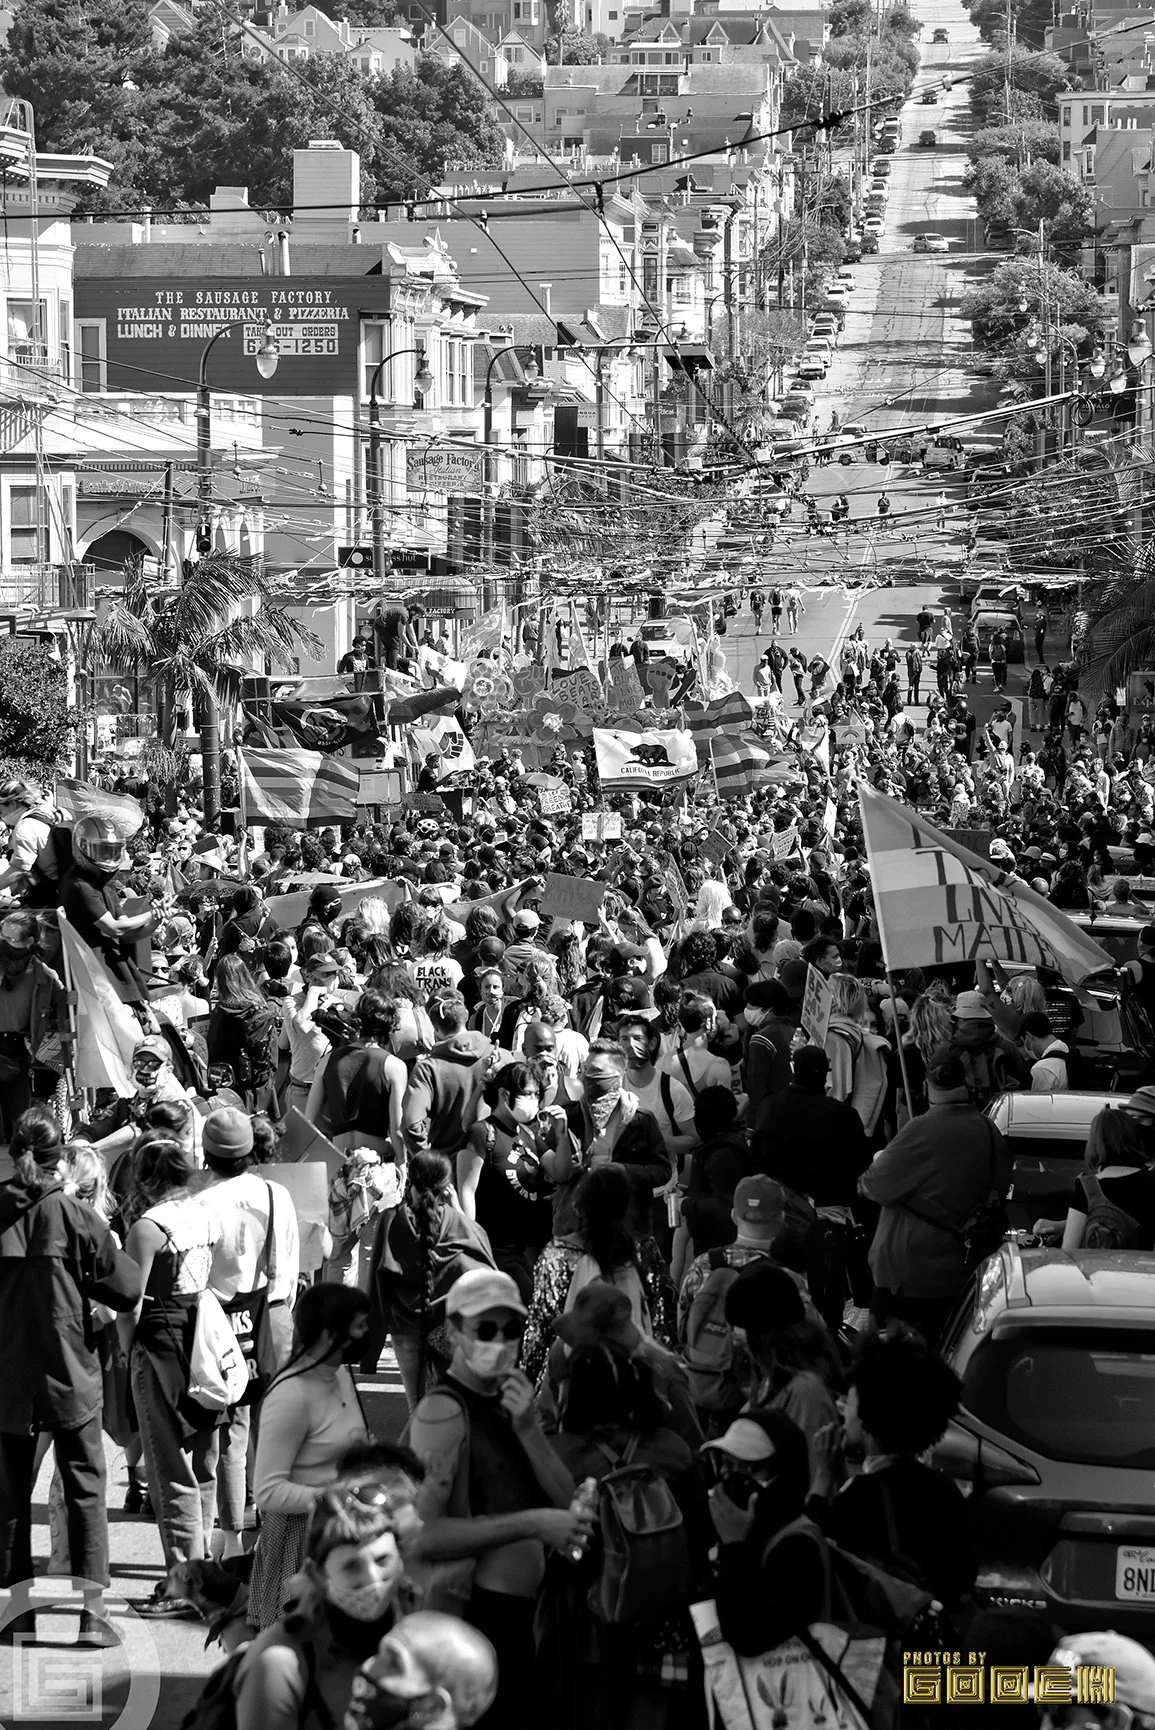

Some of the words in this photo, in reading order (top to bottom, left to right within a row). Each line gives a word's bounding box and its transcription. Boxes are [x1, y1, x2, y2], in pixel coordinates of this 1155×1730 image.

[155, 291, 183, 303] THE
[195, 291, 259, 303] SAUSAGE
[117, 307, 172, 320] ITALIAN
[180, 307, 268, 320] RESTAURANT
[273, 308, 282, 320] &
[288, 307, 349, 320] PIZZERIA
[117, 323, 163, 338] LUNCH
[168, 323, 177, 337] &
[246, 326, 267, 337] TAK
[276, 326, 293, 337] OUT
[301, 326, 336, 337] ORDERS
[247, 339, 336, 353] 66-1250
[407, 454, 444, 470] Sausage
[560, 681, 599, 702] BEATS
[543, 800, 571, 812] BREATHE
[417, 966, 447, 977] BLACK
[416, 977, 452, 989] TRANS
